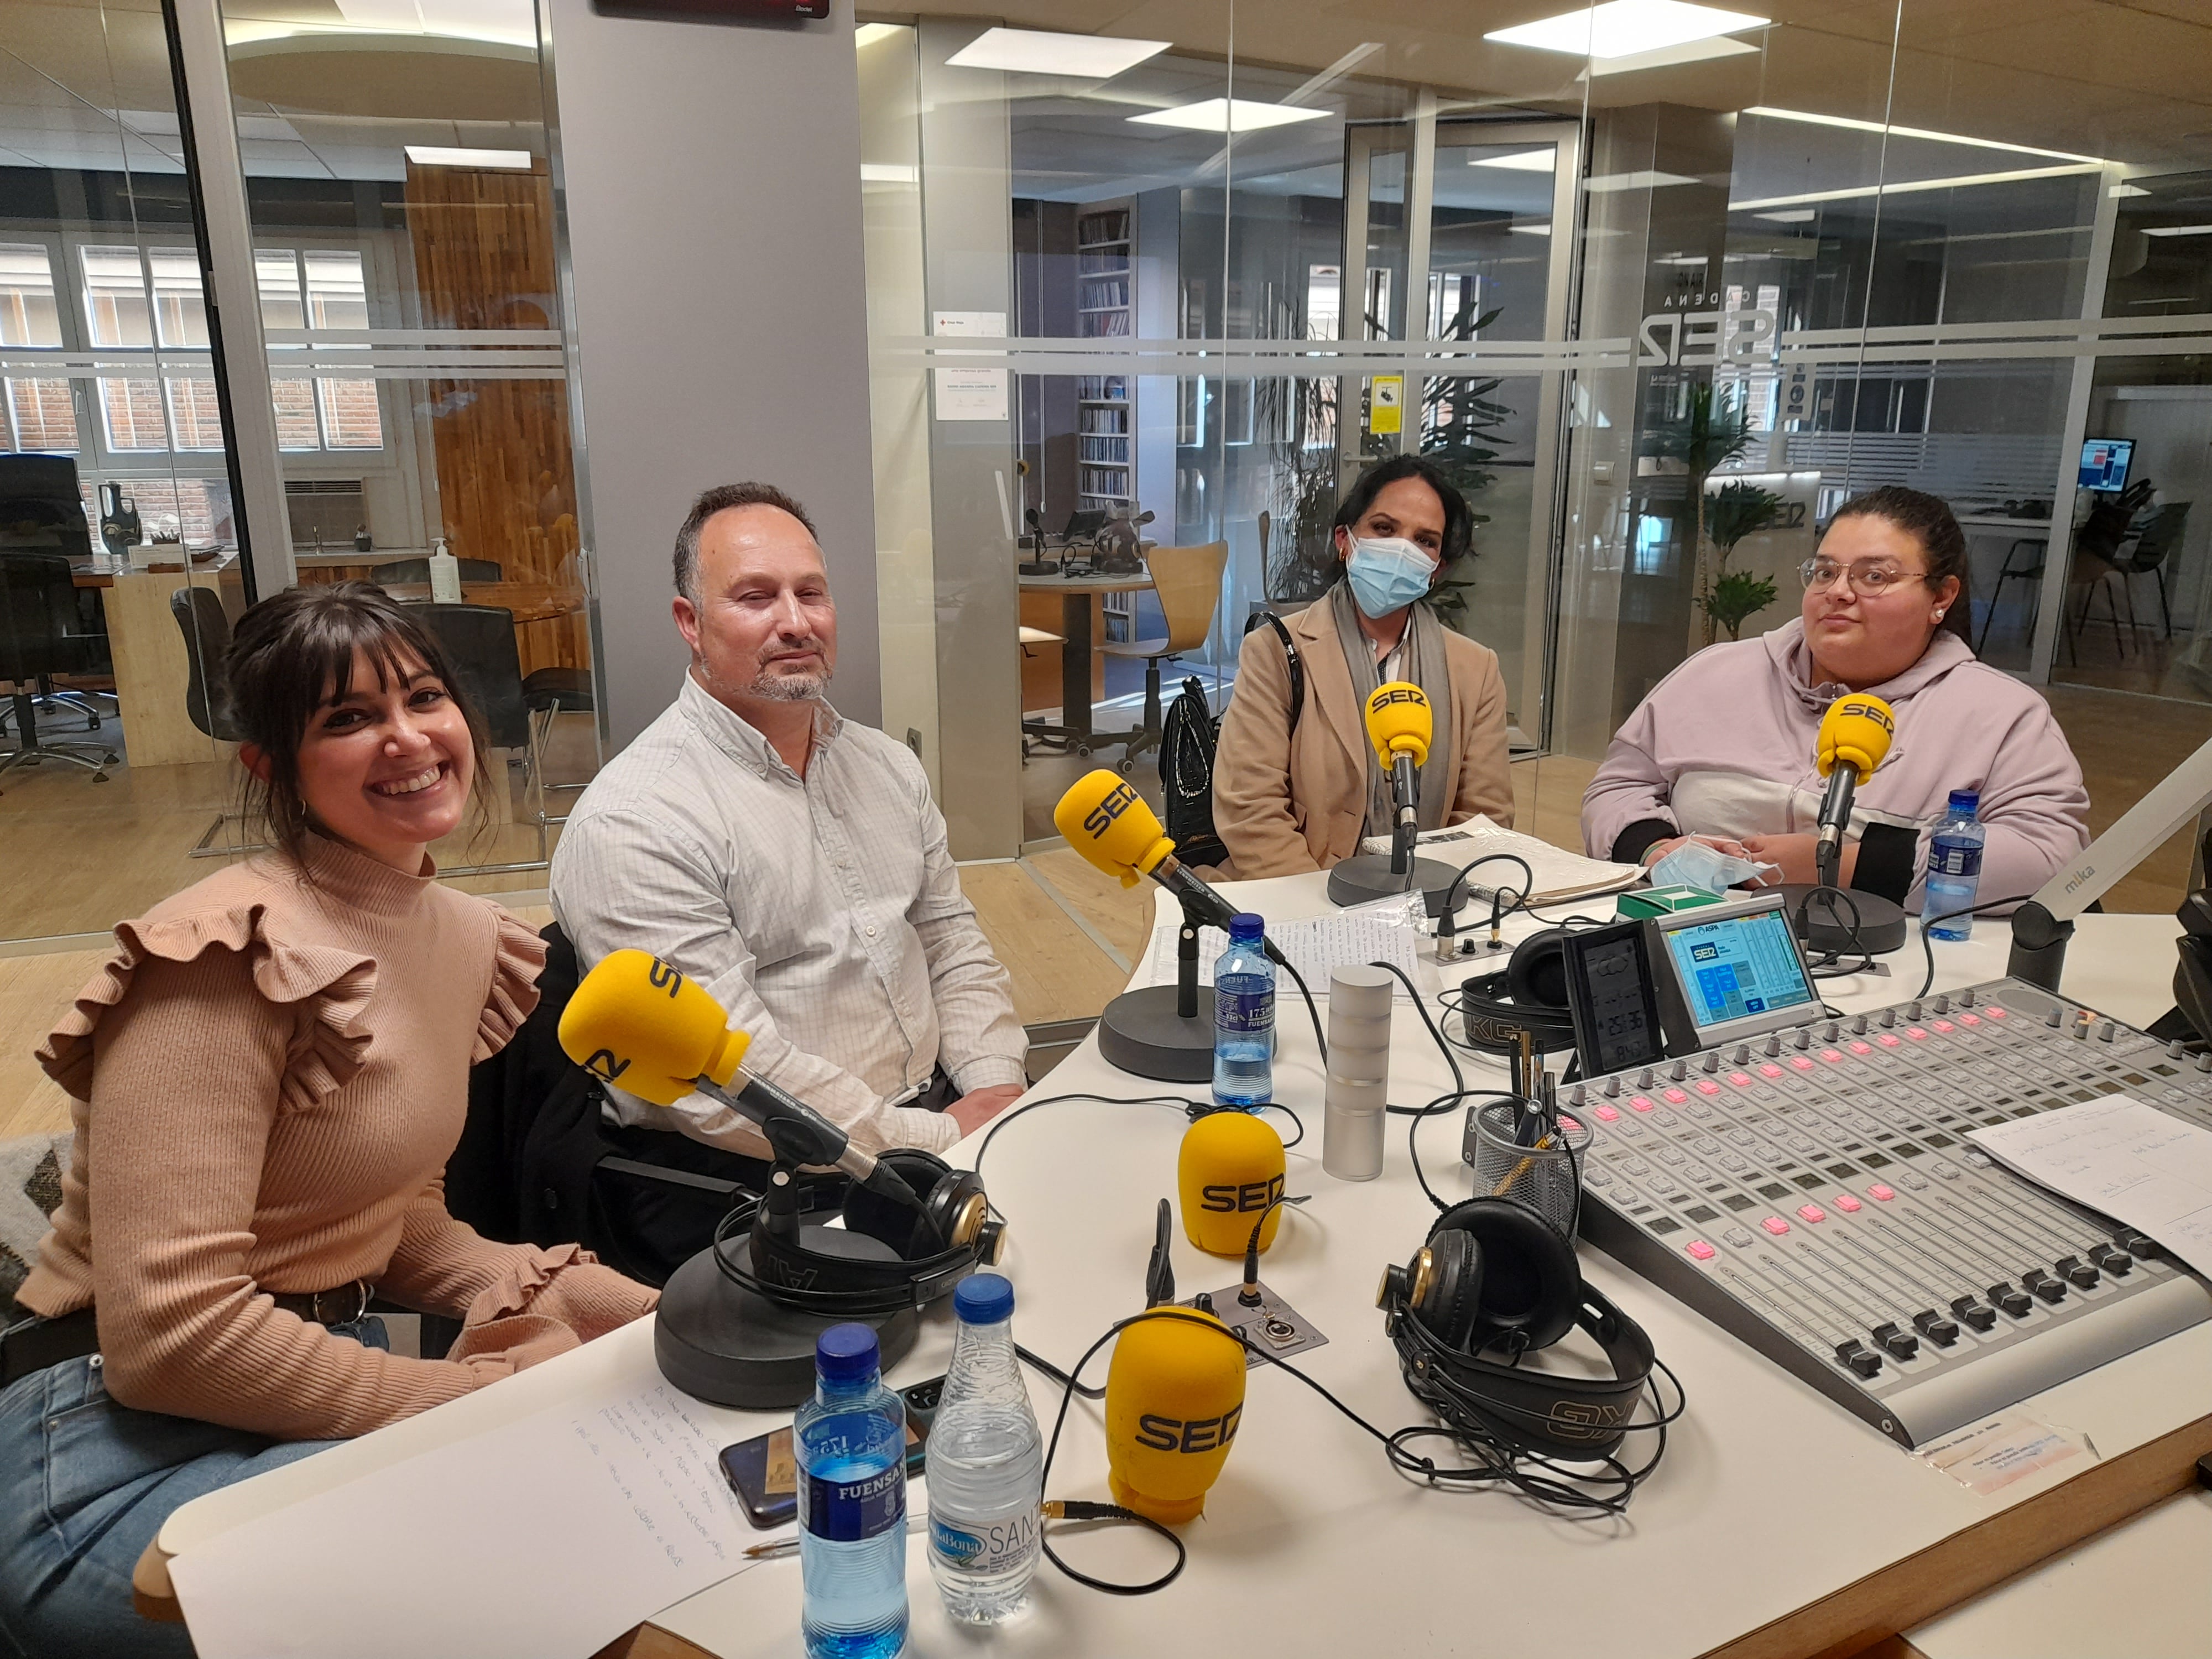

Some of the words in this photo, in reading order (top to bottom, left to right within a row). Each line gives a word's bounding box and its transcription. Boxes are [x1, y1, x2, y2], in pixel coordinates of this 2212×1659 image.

[1372, 690, 1427, 714] SER
[1840, 703, 1895, 742] SER
[1084, 782, 1139, 840] SER
[1705, 925, 1720, 933] ASPA
[1694, 947, 1717, 960] SER
[1249, 1008, 1265, 1019] 175
[1201, 1172, 1285, 1213] SER
[1135, 1401, 1244, 1453] SER
